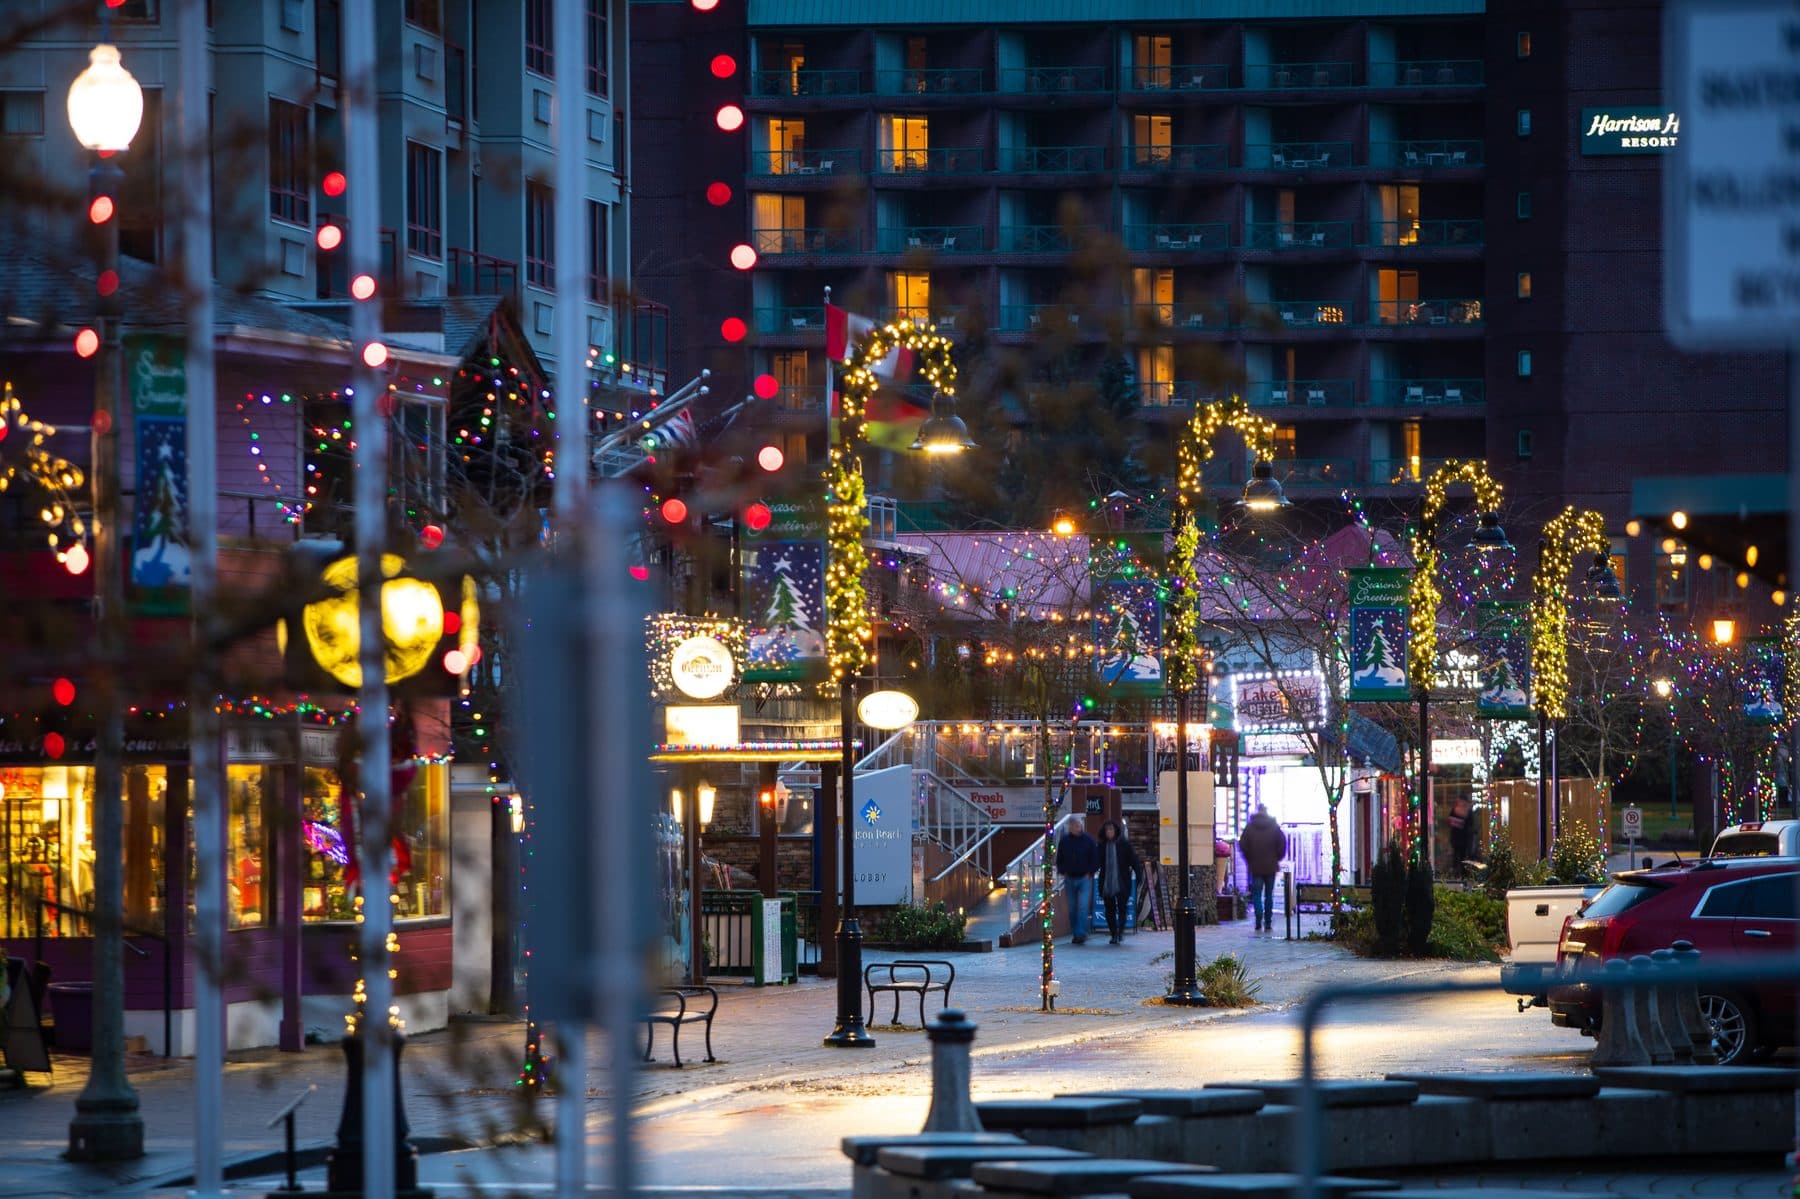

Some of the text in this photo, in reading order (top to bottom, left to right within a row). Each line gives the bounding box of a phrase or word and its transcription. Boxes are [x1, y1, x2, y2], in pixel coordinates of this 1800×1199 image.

[1586, 114, 1661, 136] Harrison
[1621, 137, 1677, 148] RESORT
[746, 519, 823, 537] Geetings
[1358, 576, 1403, 590] Season's
[1353, 589, 1405, 605] Greetings
[1434, 670, 1484, 689] OTEL
[1242, 686, 1312, 702] Lakeew
[970, 792, 1004, 804] Fresh
[984, 805, 1007, 819] dge
[855, 829, 874, 841] ison
[854, 873, 887, 882] LOBBY
